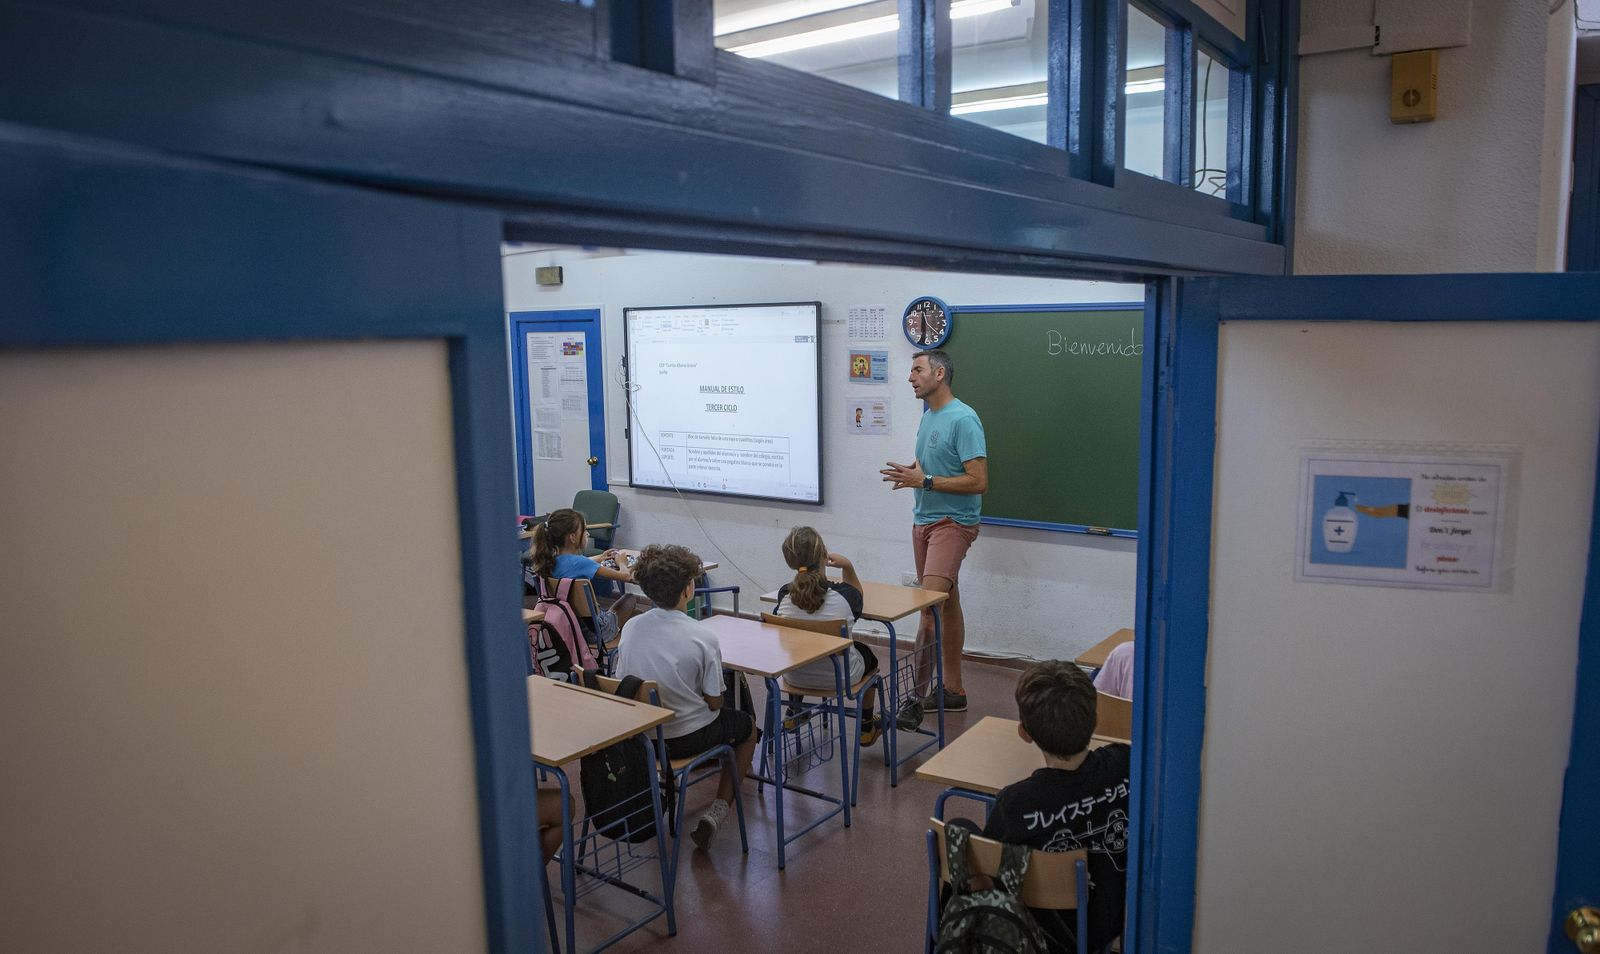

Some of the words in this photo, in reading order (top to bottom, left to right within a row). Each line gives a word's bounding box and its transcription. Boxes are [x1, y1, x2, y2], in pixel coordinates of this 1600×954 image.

[700, 385, 720, 393] MANUAL
[728, 386, 744, 394] ESTILO
[724, 404, 737, 412] CICLO
[1023, 779, 1129, 831] プレイステーショ
